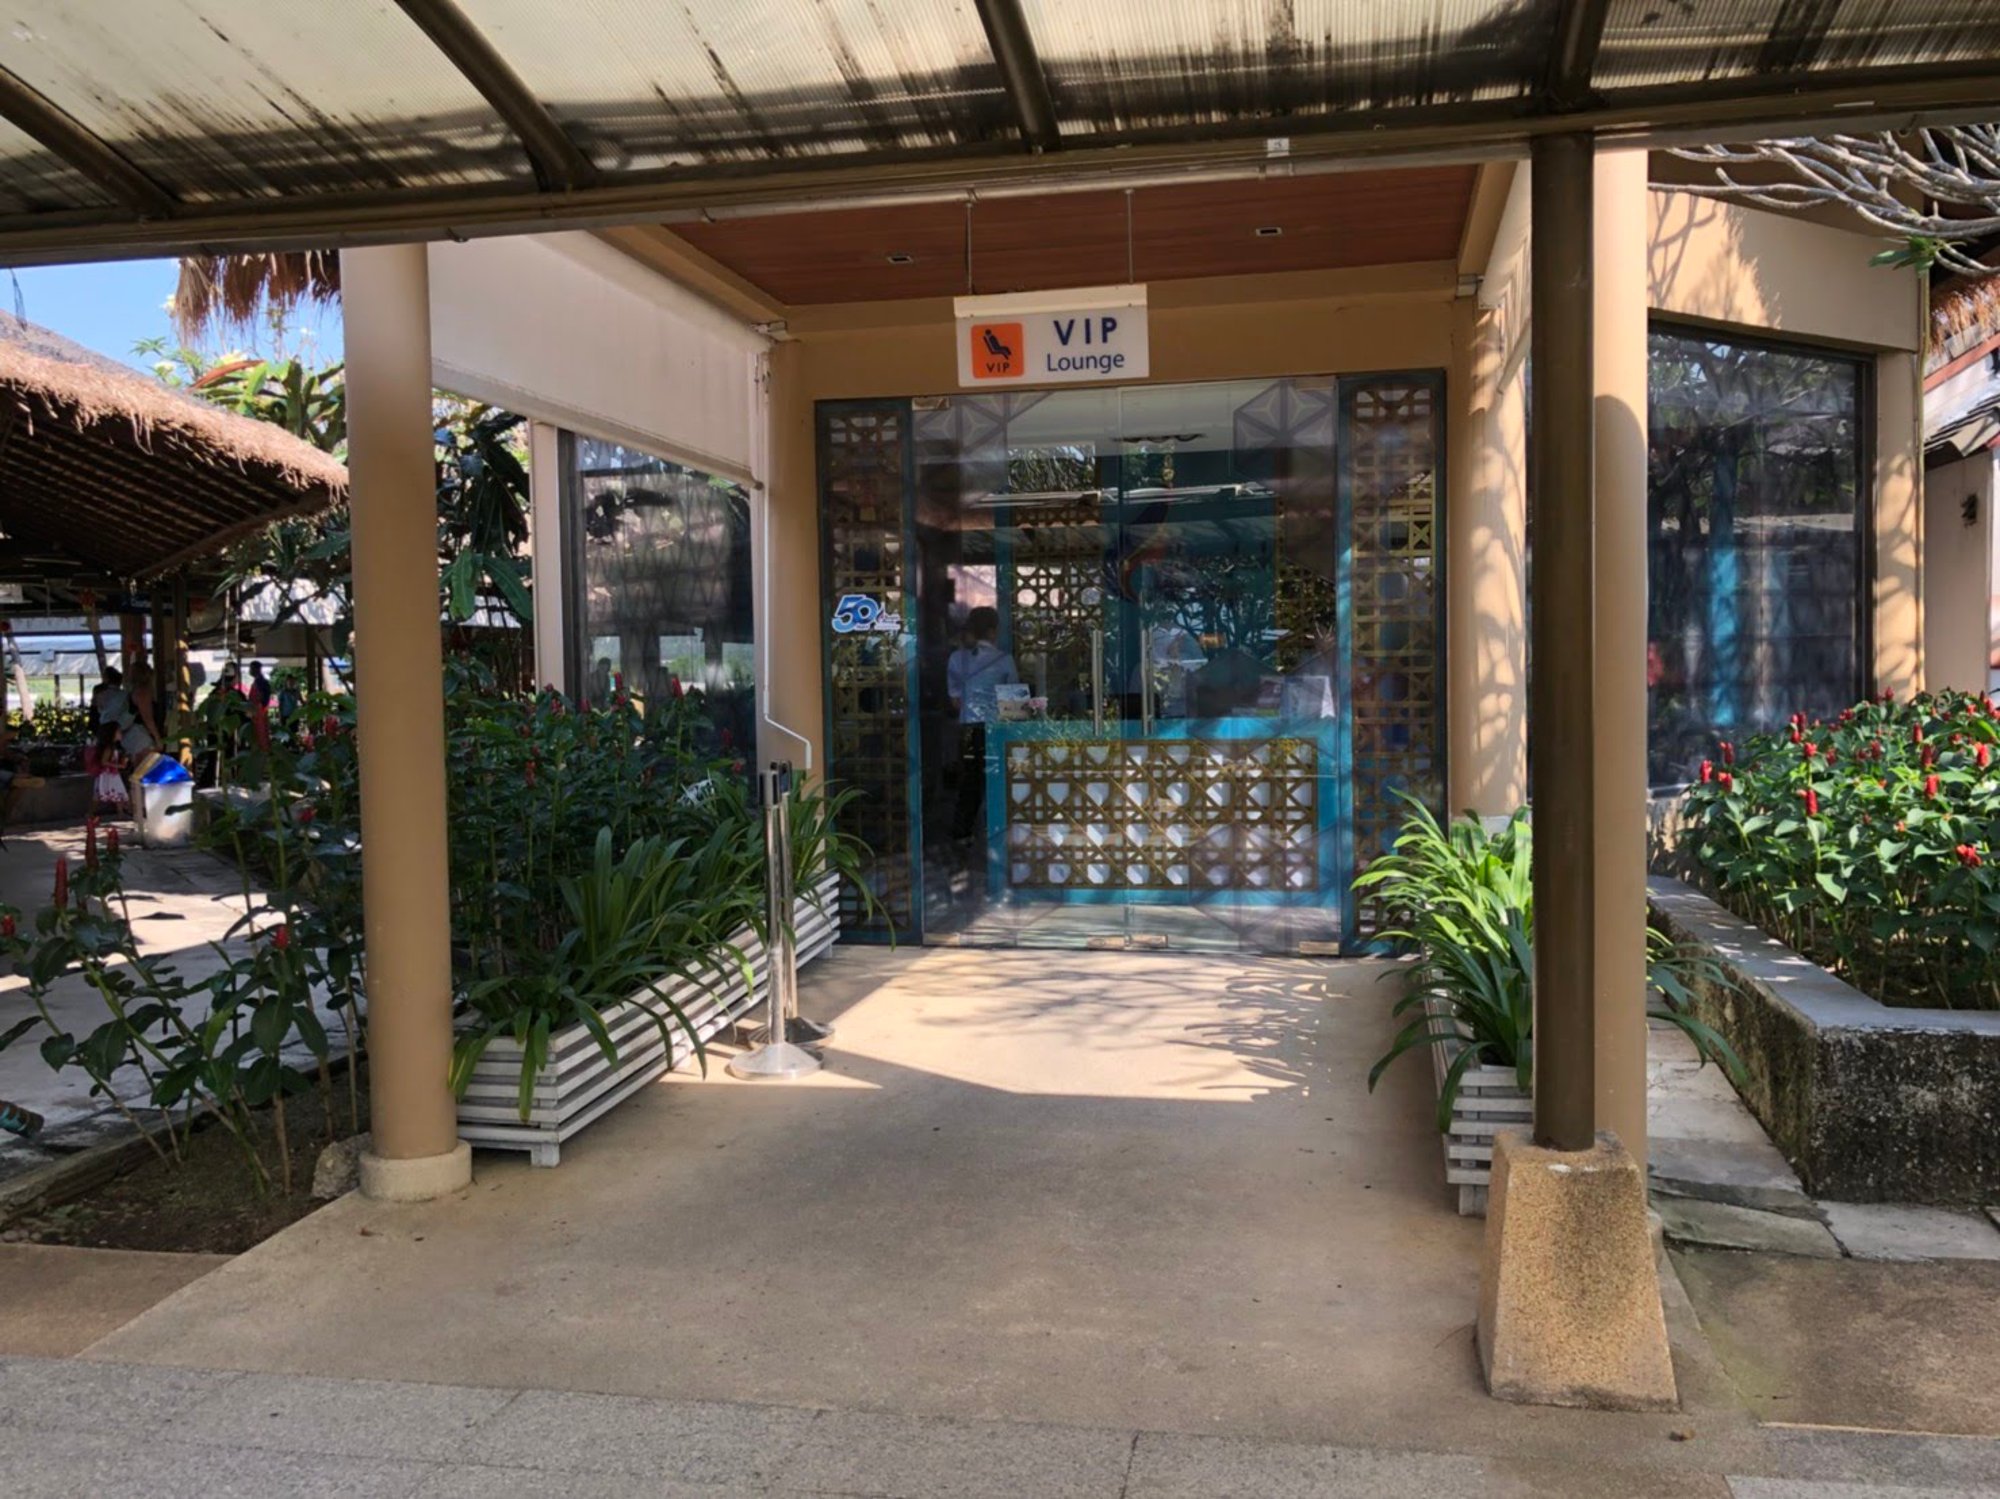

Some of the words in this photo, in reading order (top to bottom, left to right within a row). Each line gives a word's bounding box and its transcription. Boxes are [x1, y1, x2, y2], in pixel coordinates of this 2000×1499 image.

[1053, 317, 1117, 346] VIP
[986, 362, 1010, 373] VIP
[1047, 353, 1125, 373] Lounge
[832, 594, 878, 633] 50
